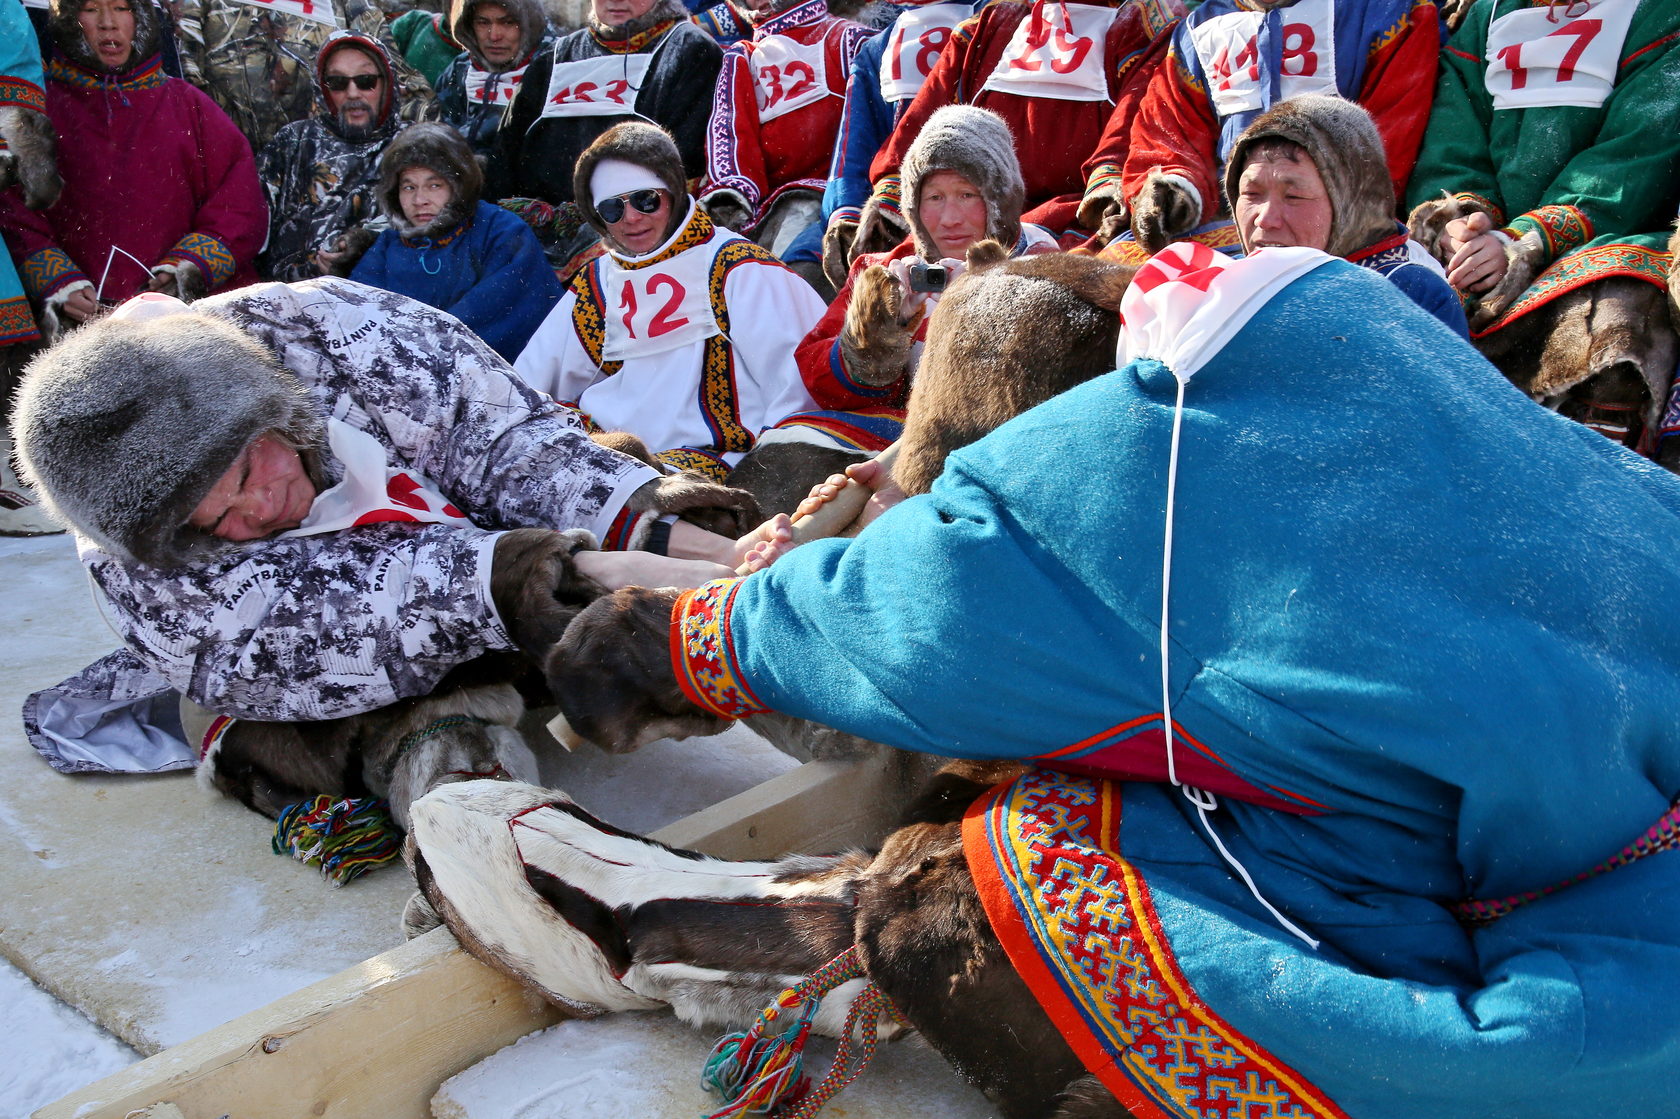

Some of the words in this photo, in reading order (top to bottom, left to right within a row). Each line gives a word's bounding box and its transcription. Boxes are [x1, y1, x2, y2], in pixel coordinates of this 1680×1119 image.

[892, 27, 951, 80] 18
[1497, 18, 1603, 91] 17
[618, 272, 690, 340] 12
